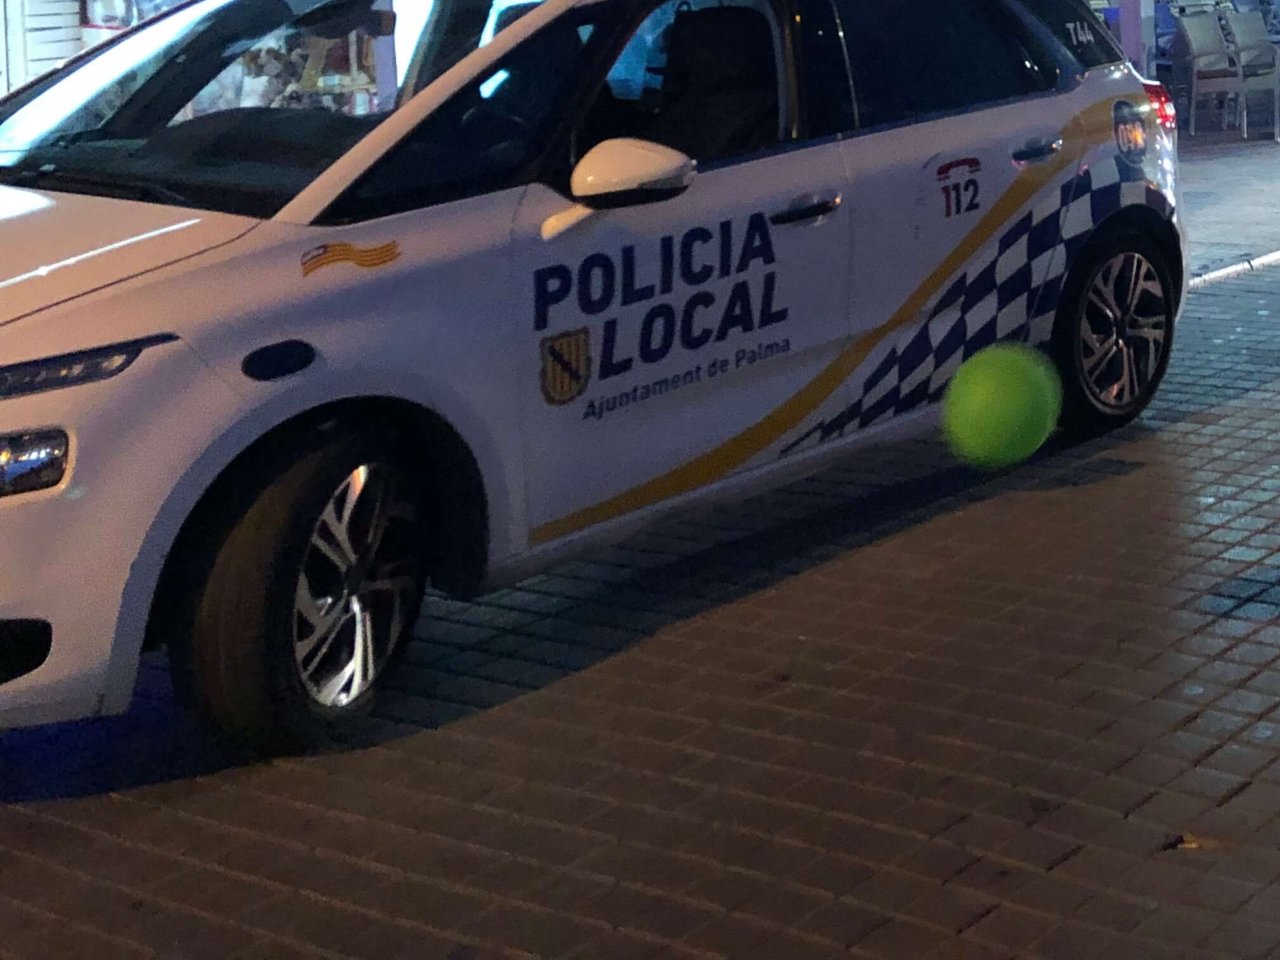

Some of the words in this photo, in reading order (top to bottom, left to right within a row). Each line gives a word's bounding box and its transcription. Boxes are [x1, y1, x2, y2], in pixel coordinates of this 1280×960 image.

[1066, 21, 1095, 45] T44
[940, 177, 980, 218] 112
[533, 212, 776, 331] POLICIA
[598, 271, 789, 380] LOCAL
[582, 365, 704, 420] Ajuntament
[707, 357, 730, 379] de
[735, 338, 791, 368] Palma
